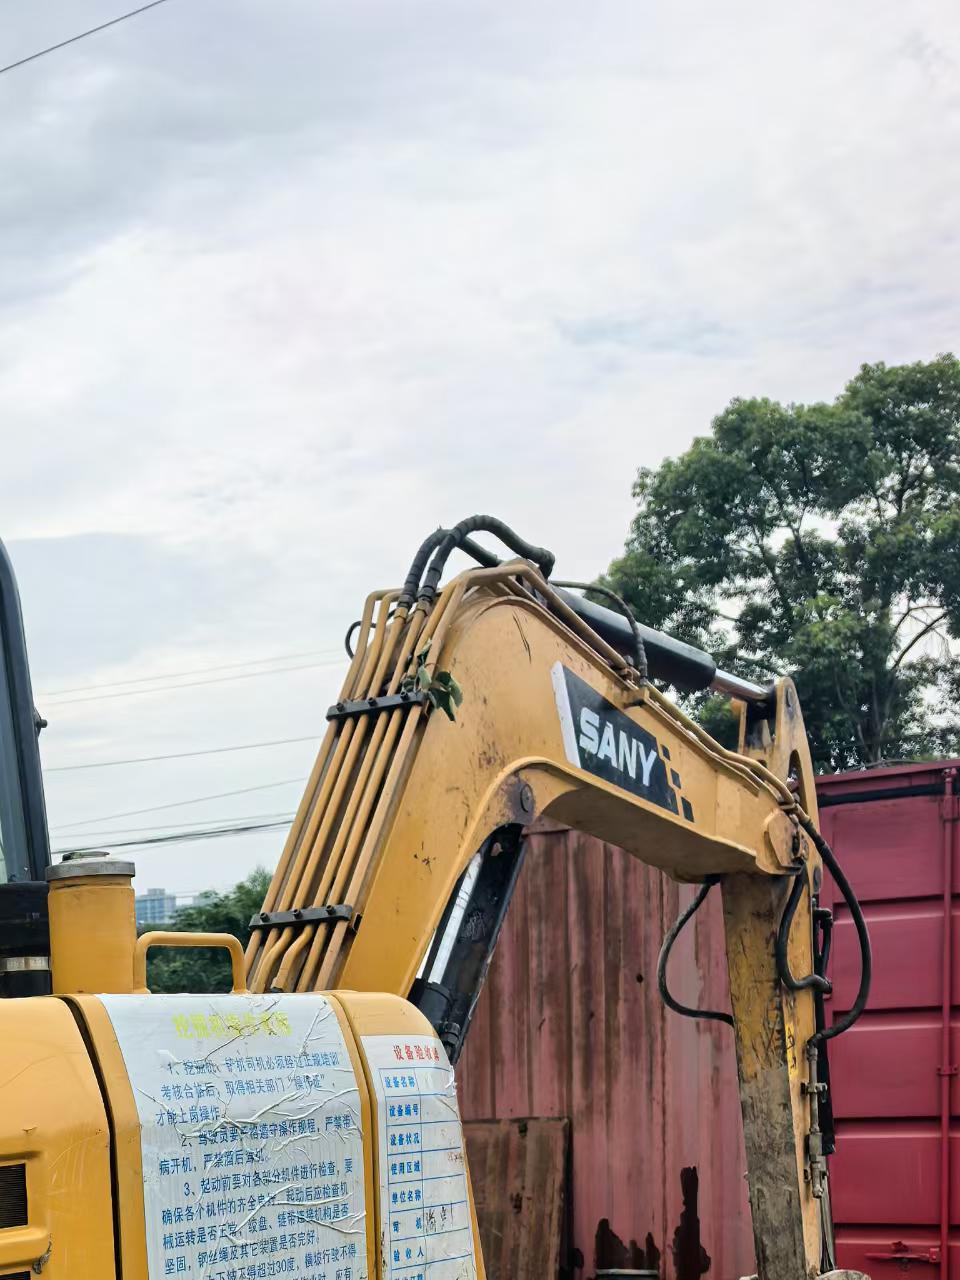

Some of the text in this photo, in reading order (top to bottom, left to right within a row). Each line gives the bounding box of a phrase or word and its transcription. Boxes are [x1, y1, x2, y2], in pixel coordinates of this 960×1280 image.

[579, 707, 657, 787] SANY
[385, 1076, 416, 1089] 设备名称
[389, 1104, 419, 1117] 设备编号
[390, 1132, 420, 1146] 设备状况
[391, 1160, 420, 1175] 使用区域
[392, 1188, 421, 1205] 单位名称
